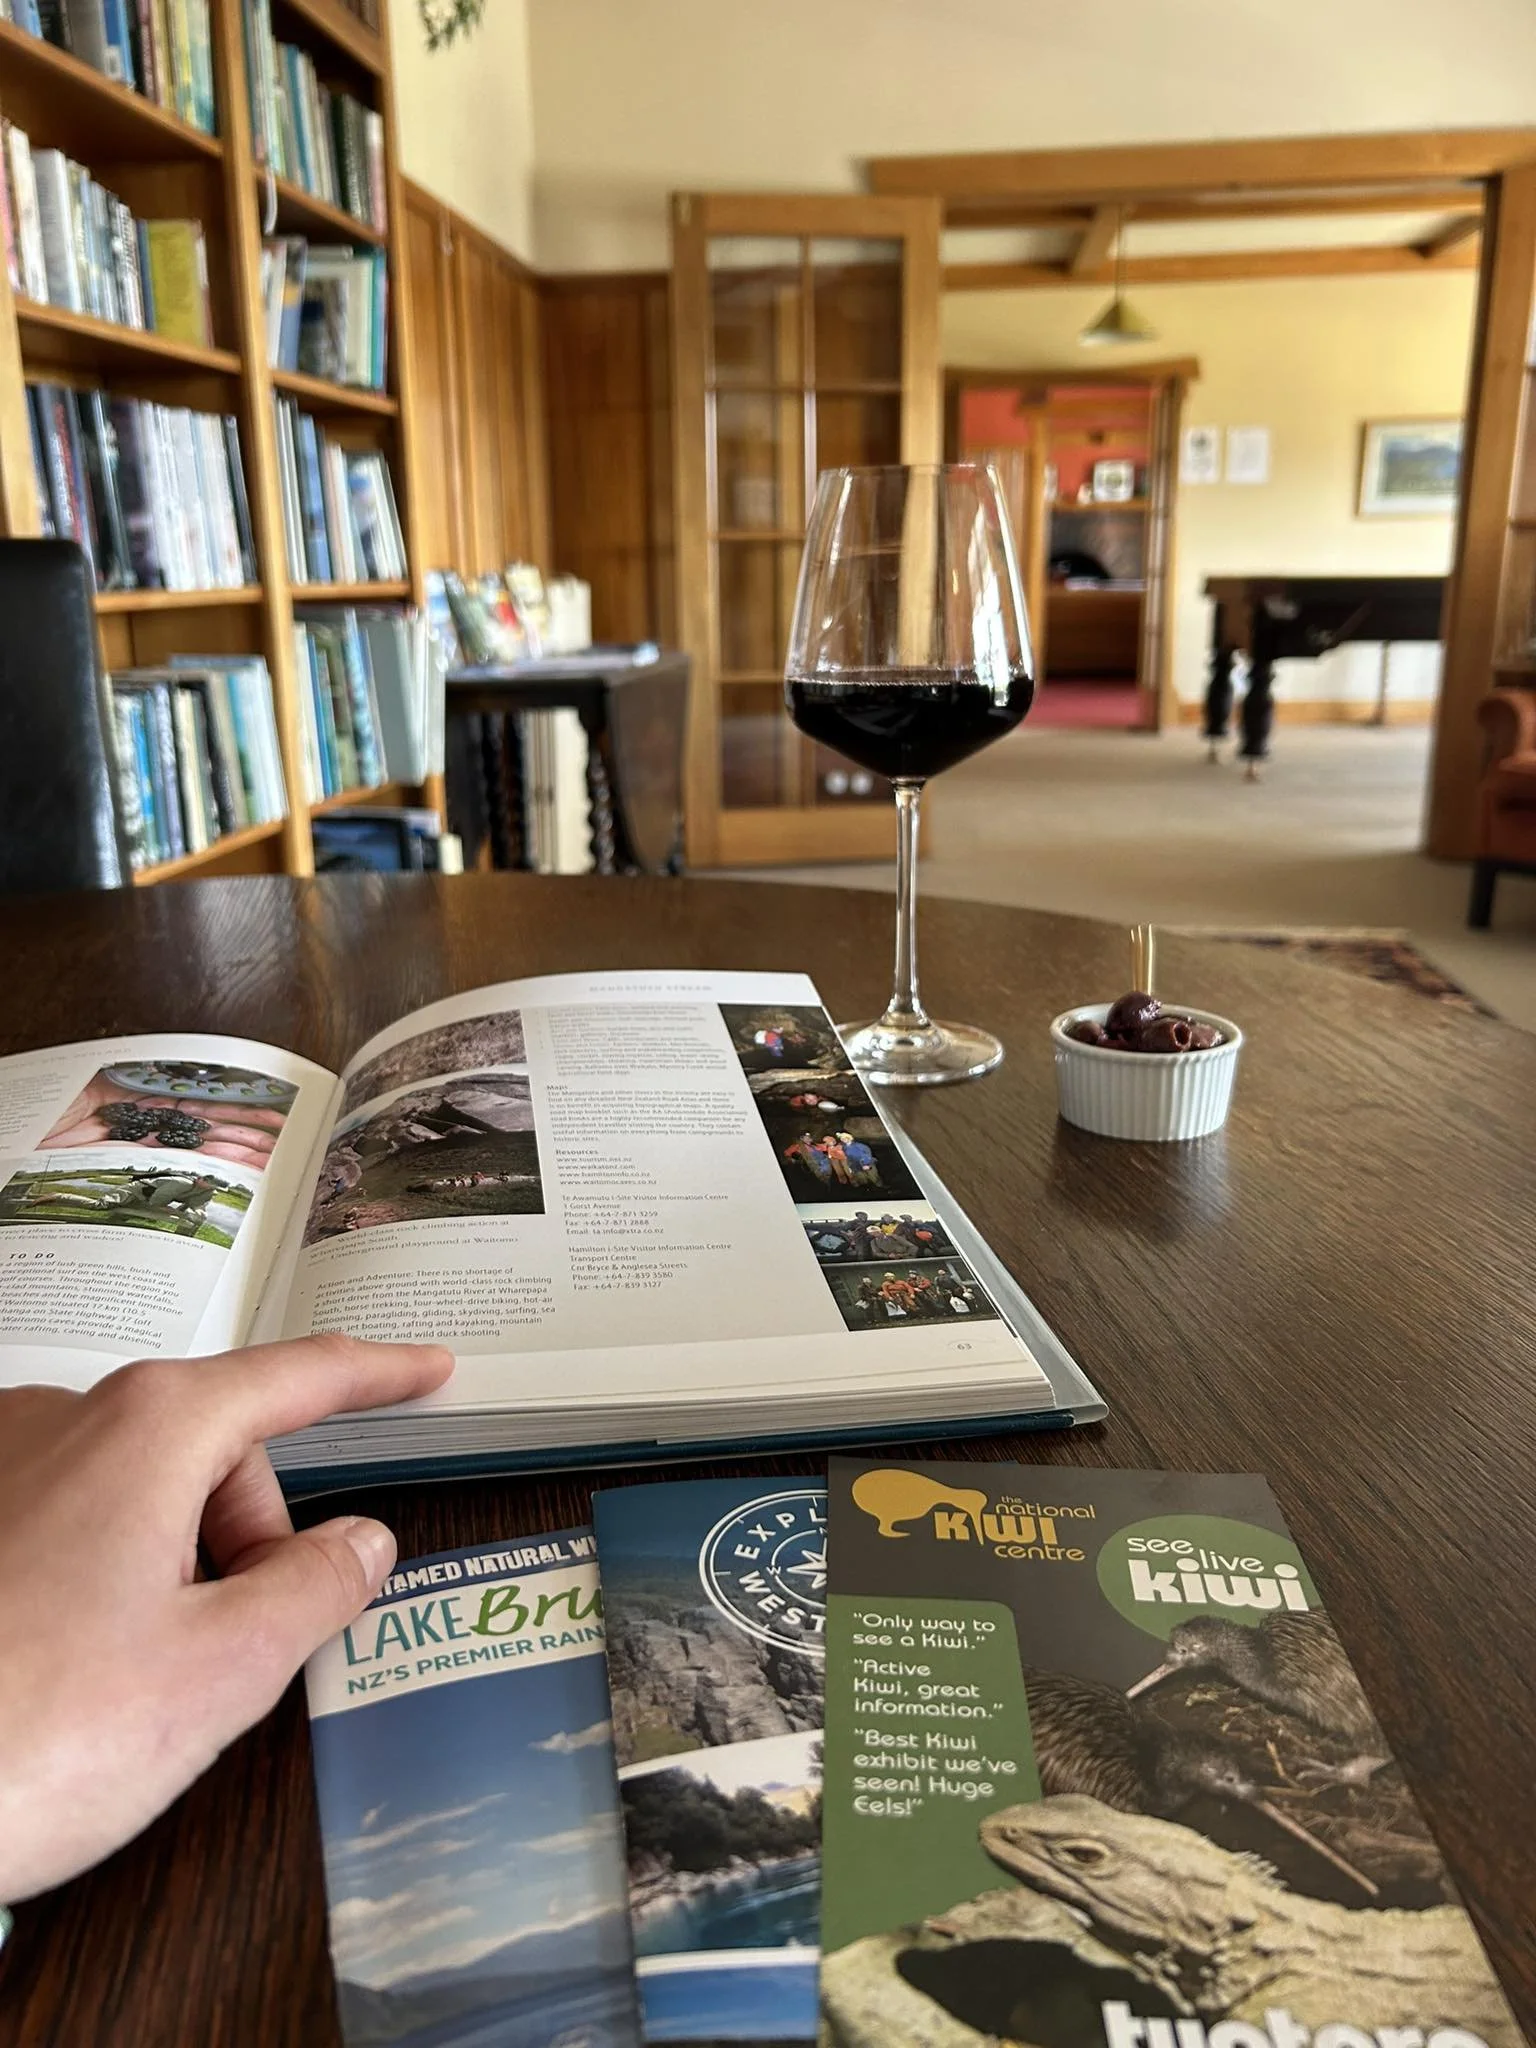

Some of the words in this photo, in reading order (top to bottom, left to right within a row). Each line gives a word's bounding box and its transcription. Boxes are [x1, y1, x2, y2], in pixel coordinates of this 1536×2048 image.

[569, 1255, 609, 1263] Transport
[315, 1286, 356, 1299] activities
[357, 1283, 385, 1292] above
[385, 1281, 418, 1291] ground
[420, 1278, 441, 1287] with
[494, 1277, 513, 1285] rock
[514, 1276, 552, 1285] climbing
[317, 1280, 345, 1290] Action
[347, 1275, 364, 1284] and
[417, 1269, 441, 1277] There
[465, 1268, 503, 1277] shortage
[322, 1297, 345, 1307] short
[347, 1293, 370, 1303] drive
[371, 1290, 394, 1300] from
[396, 1289, 411, 1298] the
[463, 1287, 487, 1296] River
[498, 1286, 548, 1296] Wharepapa
[344, 1303, 370, 1313] horse
[346, 1322, 360, 1333] jet
[402, 1318, 434, 1329] rafting
[435, 1318, 453, 1328] and
[499, 1317, 543, 1326] mountain
[364, 1332, 392, 1341] target
[394, 1331, 412, 1339] and
[414, 1330, 435, 1338] wild
[436, 1329, 458, 1338] duck
[957, 1343, 972, 1351] 63
[1001, 1495, 1023, 1504] the
[995, 1502, 1096, 1519] national
[993, 1544, 1086, 1561] centre
[1126, 1537, 1194, 1554] see
[377, 1560, 462, 1599] TAMED
[466, 1542, 571, 1577] NATURAL
[1199, 1548, 1265, 1573] live
[1127, 1557, 1310, 1611] kiwi
[738, 1570, 827, 1633] WEST
[343, 1595, 472, 1666] LAKE
[920, 1619, 966, 1635] way
[972, 1619, 996, 1632] to
[852, 1633, 893, 1646] see
[900, 1635, 915, 1646] a
[347, 1664, 410, 1694] NZ'S
[416, 1638, 534, 1676] PREMIER
[539, 1624, 605, 1652] RAIN
[854, 1677, 909, 1697] Kiwi,
[917, 1683, 981, 1700] great
[925, 1732, 977, 1751] Kiwi
[853, 1751, 939, 1771] exhibit
[944, 1755, 1018, 1775] we've
[853, 1775, 921, 1793] seen!
[929, 1775, 995, 1800] Huge
